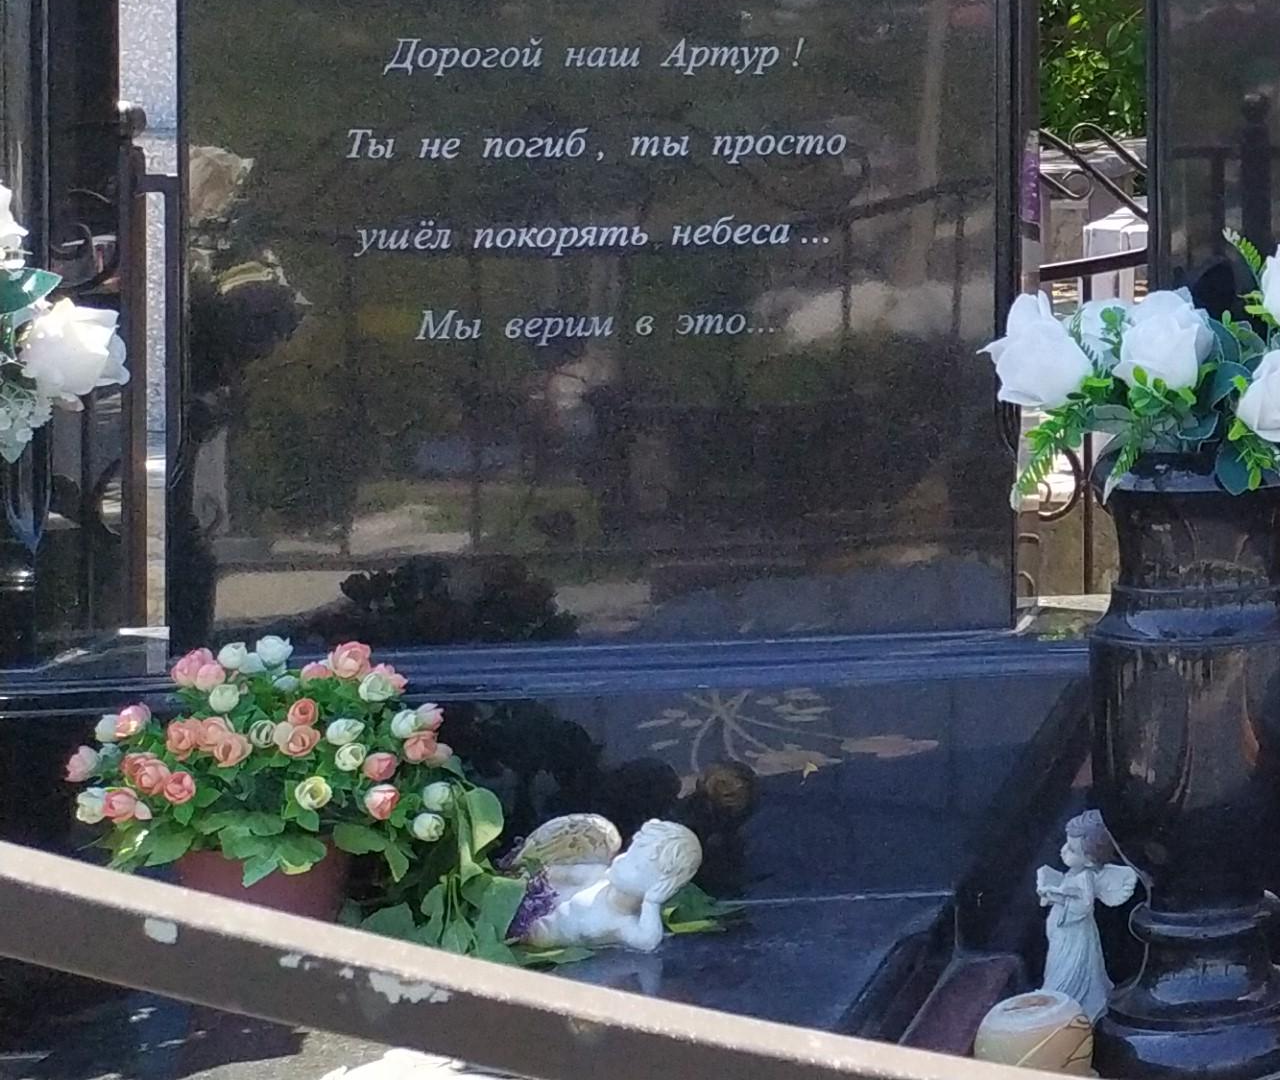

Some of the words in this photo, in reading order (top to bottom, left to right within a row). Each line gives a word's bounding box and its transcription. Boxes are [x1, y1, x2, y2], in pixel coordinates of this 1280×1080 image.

[384, 38, 542, 76] Дорогой
[565, 44, 640, 68] наш
[346, 130, 394, 160] Ты
[419, 137, 460, 159] не
[630, 134, 689, 157] ты
[711, 133, 847, 161] просто
[354, 221, 451, 256] ушёл
[473, 227, 649, 257] покорять
[416, 311, 481, 340] Мы
[505, 315, 613, 346] верим
[636, 315, 654, 336] в
